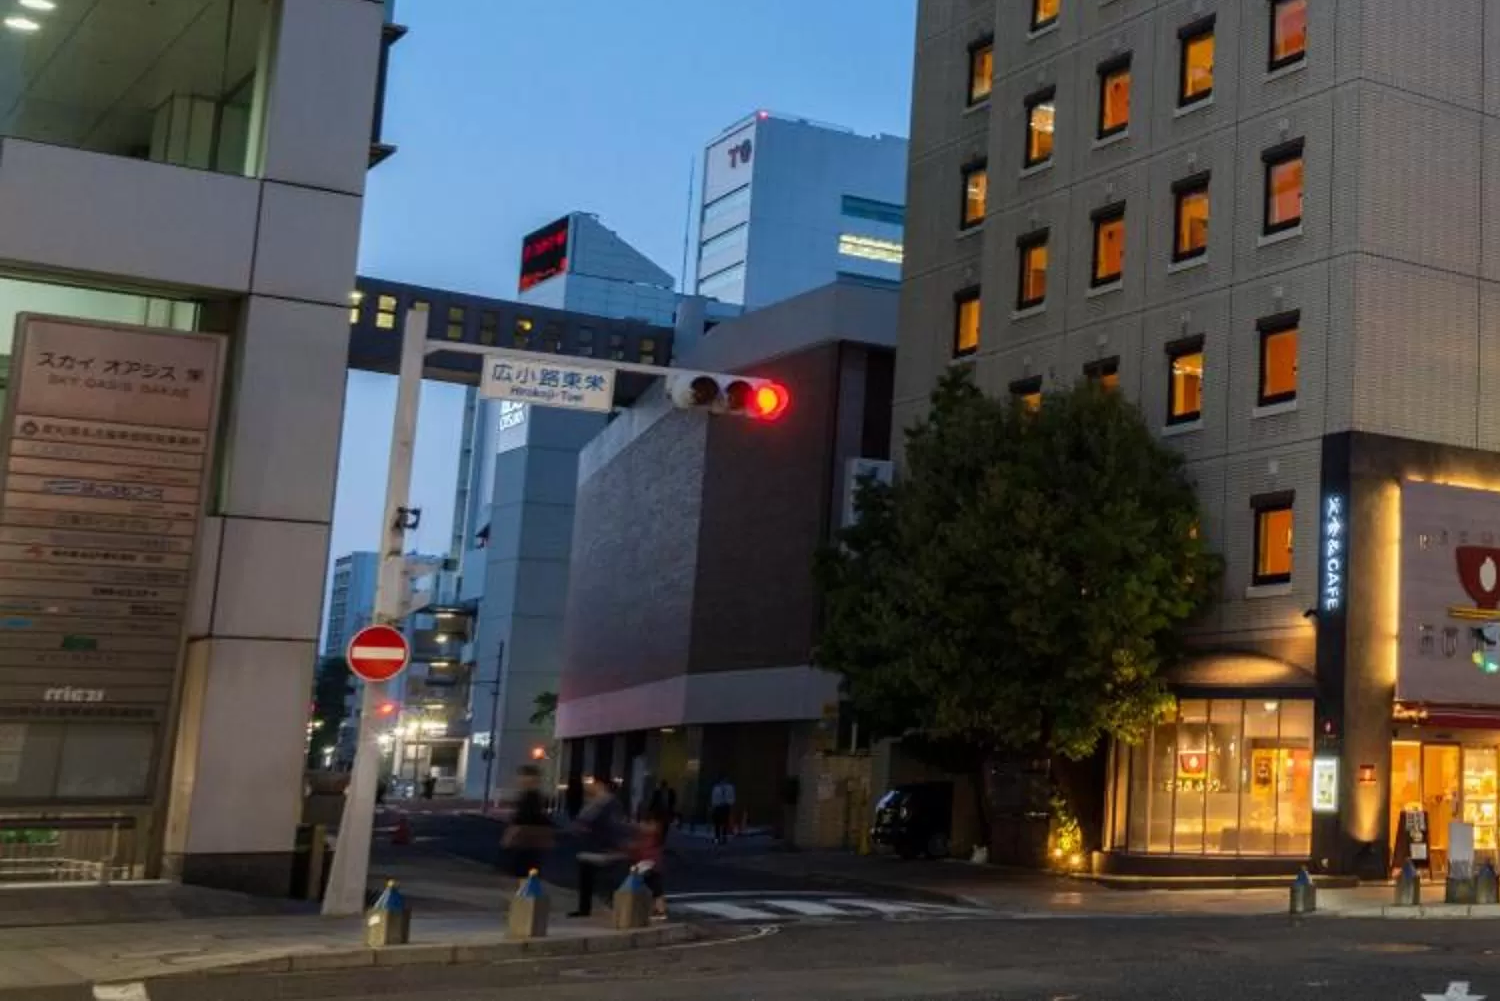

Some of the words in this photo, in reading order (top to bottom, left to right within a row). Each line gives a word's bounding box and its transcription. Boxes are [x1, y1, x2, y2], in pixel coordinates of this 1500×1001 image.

[36, 352, 95, 370] スカイ
[102, 359, 177, 381] オアシス
[491, 363, 608, 392] 広小路東栄
